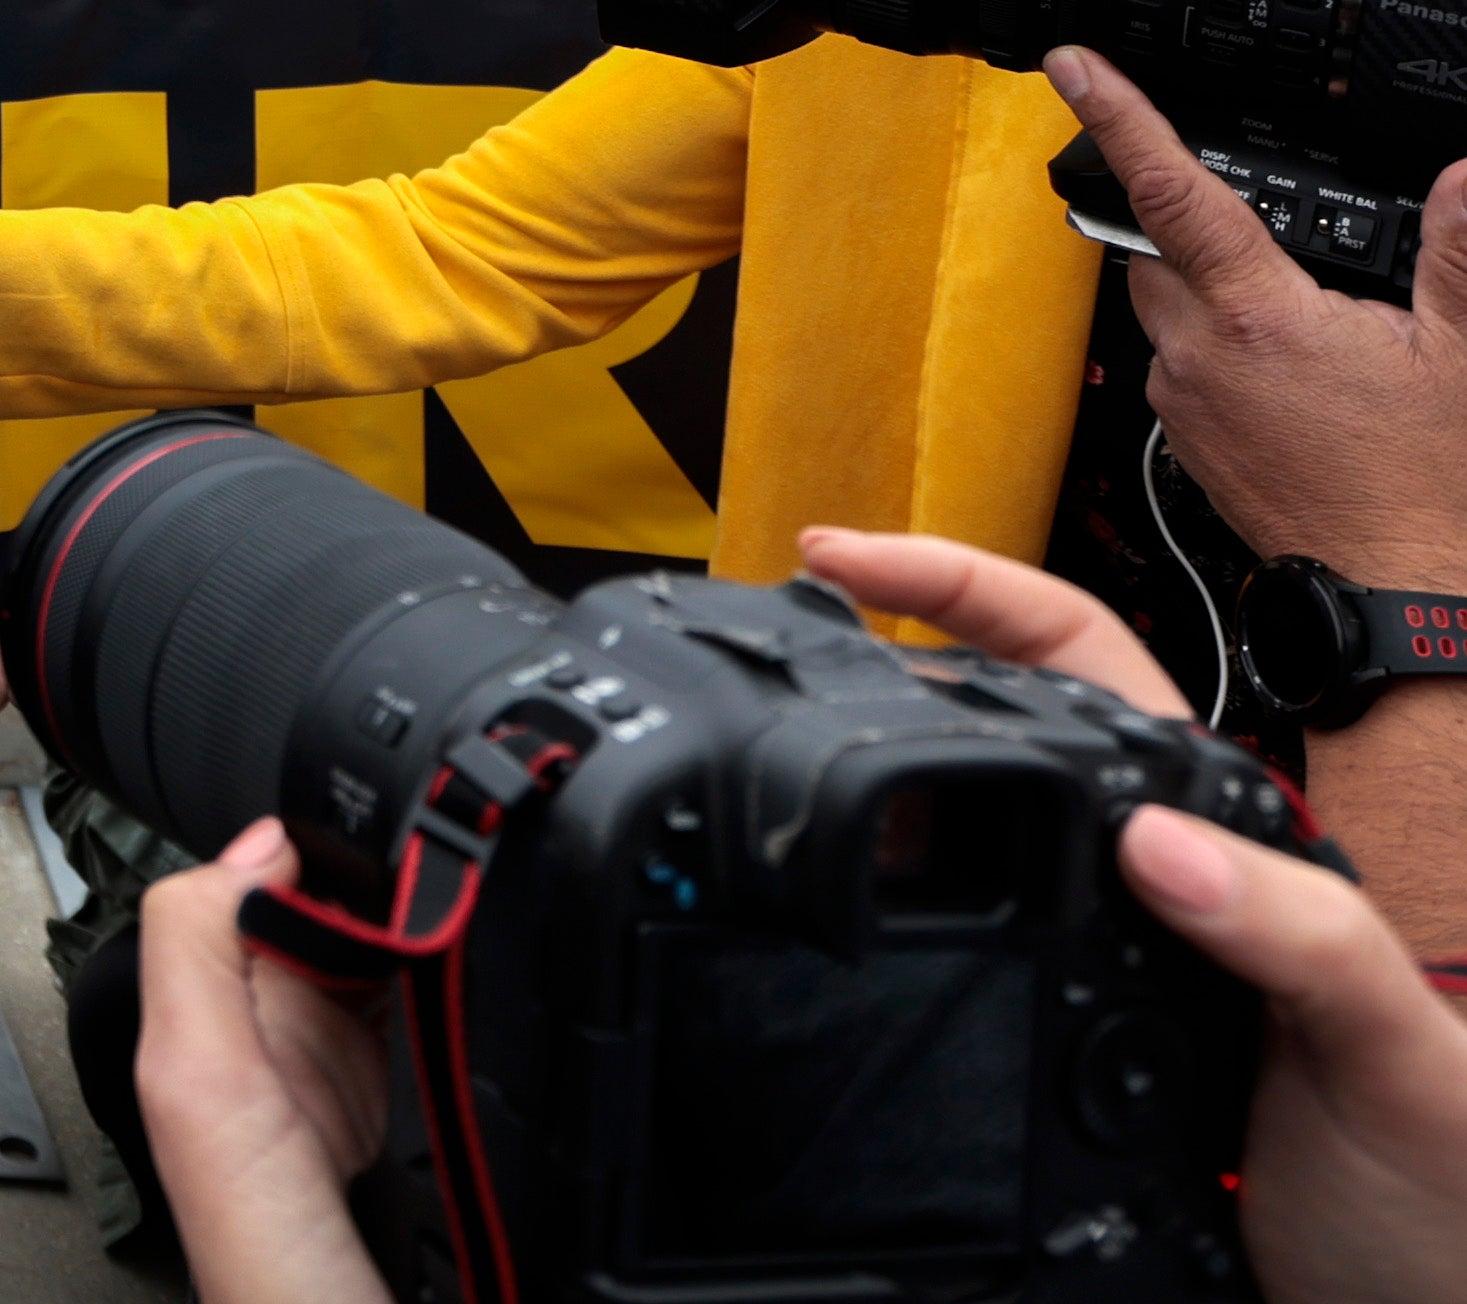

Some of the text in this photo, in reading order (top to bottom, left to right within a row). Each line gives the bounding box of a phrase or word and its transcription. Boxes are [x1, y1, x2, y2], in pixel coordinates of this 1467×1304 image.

[1266, 174, 1297, 190] GAIN
[1317, 187, 1378, 211] WHITE BAL
